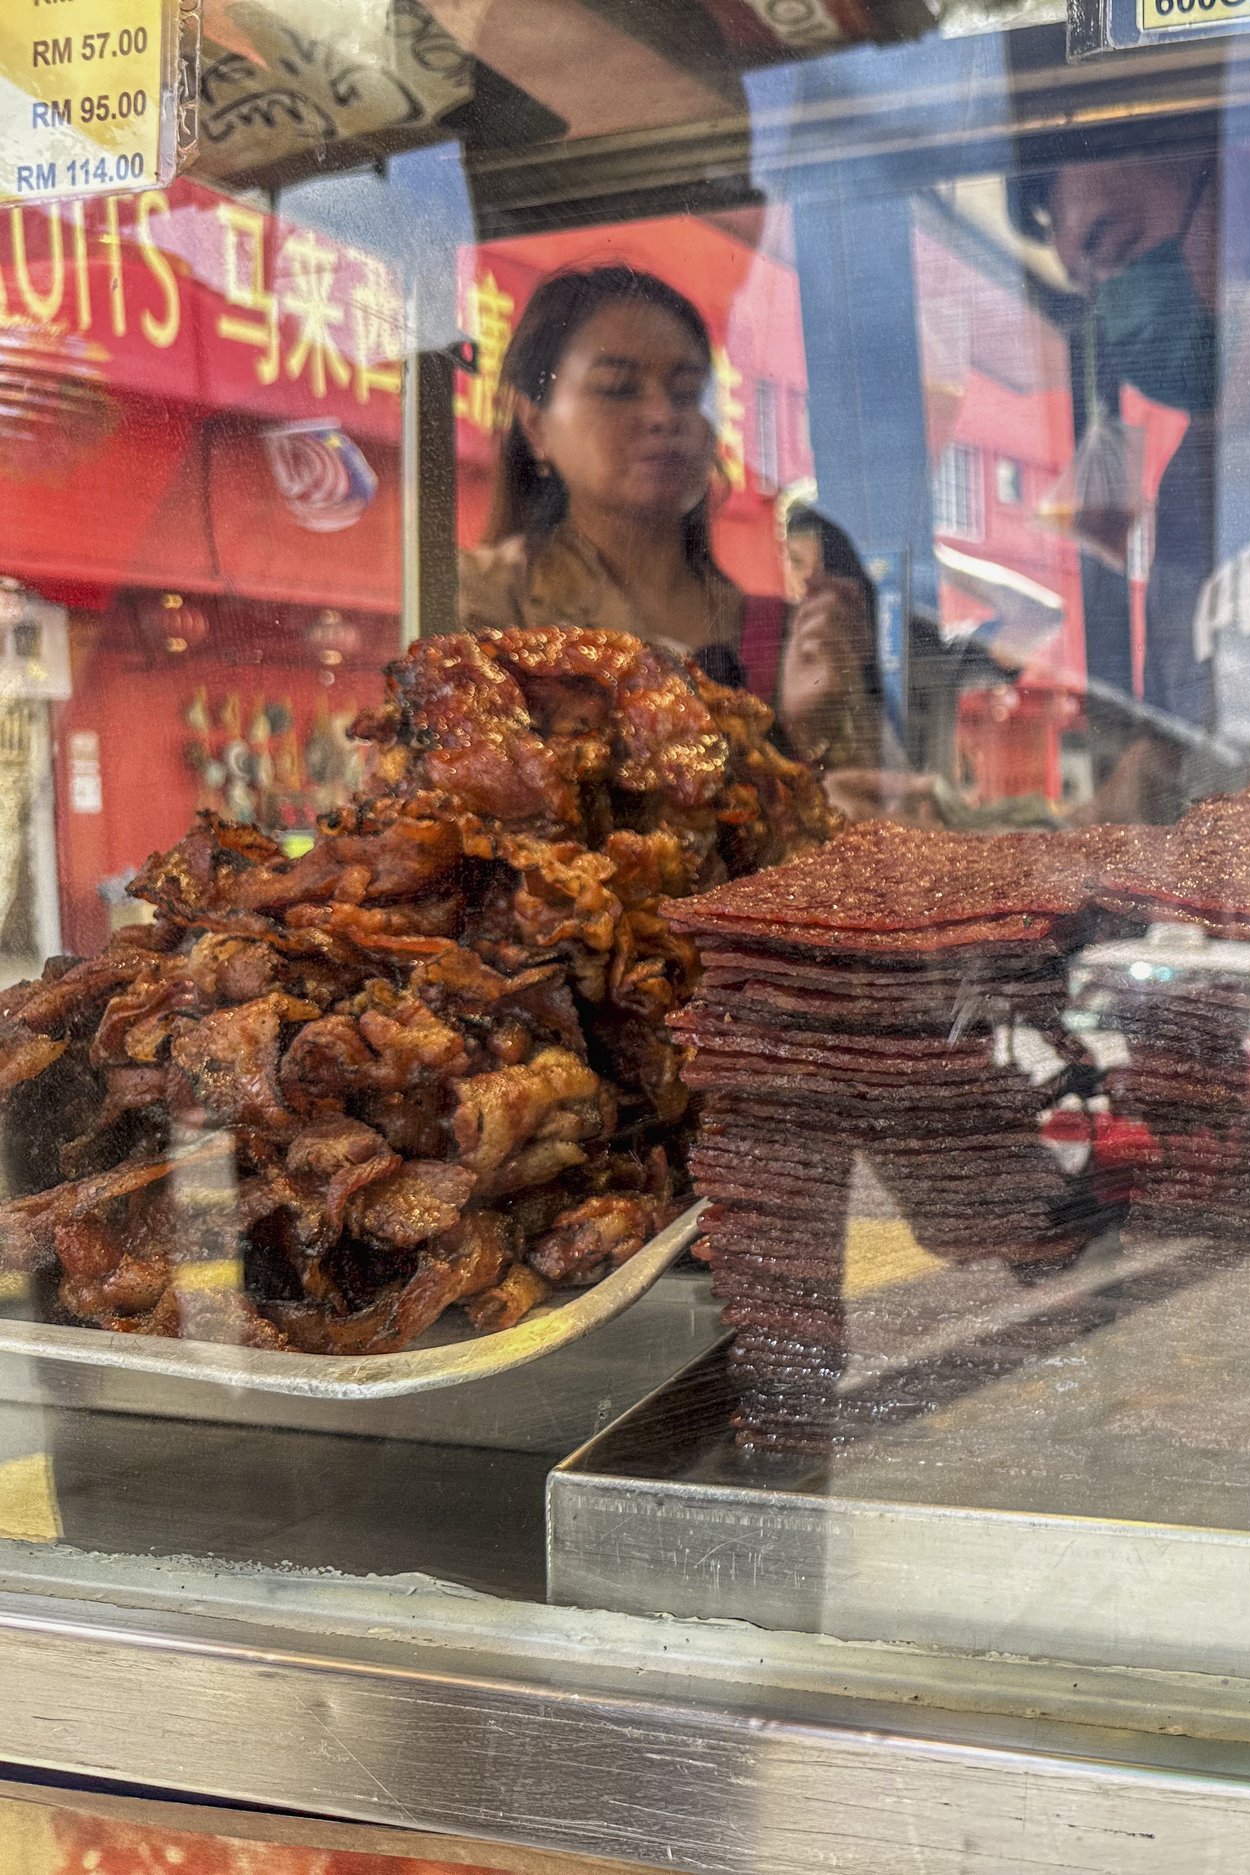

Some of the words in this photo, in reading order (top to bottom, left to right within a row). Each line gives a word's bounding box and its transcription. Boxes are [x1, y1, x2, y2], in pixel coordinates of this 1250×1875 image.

[33, 37, 72, 67] RM
[81, 26, 148, 61] 57.00
[32, 99, 72, 129] RM
[80, 89, 147, 123] 95.00
[17, 162, 57, 192] RM
[66, 152, 144, 187] 114.00
[0, 189, 181, 349] UITS
